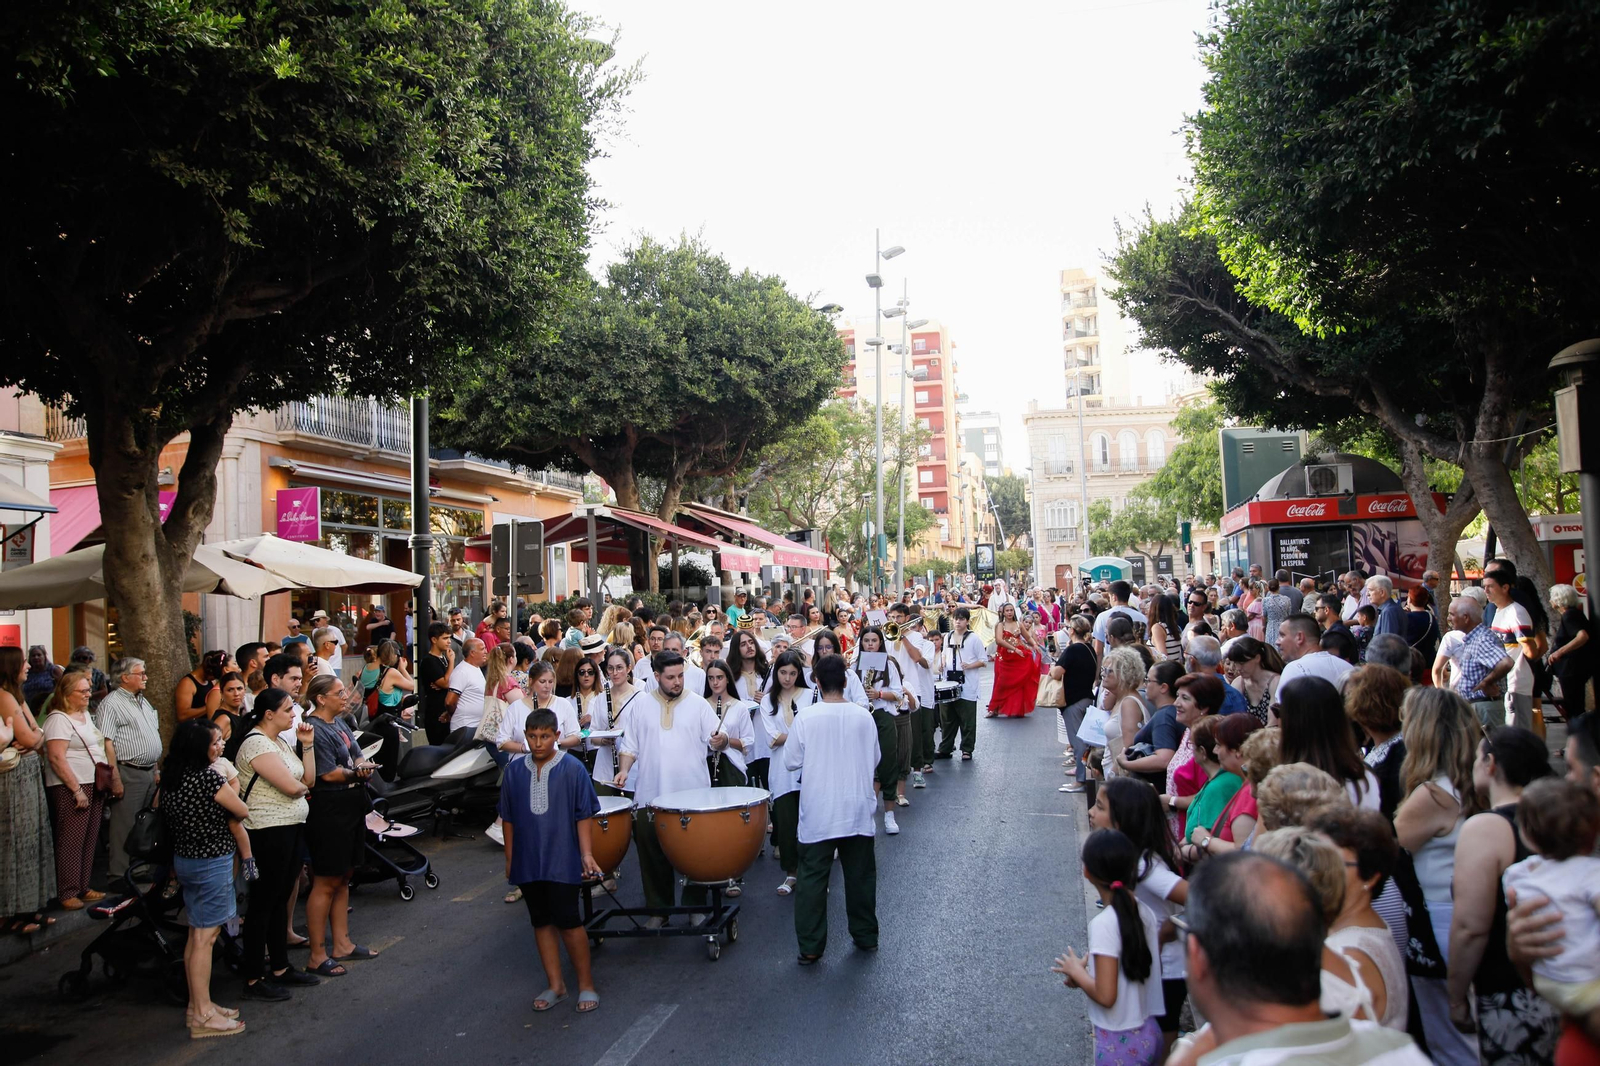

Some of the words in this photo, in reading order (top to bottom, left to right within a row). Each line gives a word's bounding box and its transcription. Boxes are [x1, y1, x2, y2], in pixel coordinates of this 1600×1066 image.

[1286, 503, 1328, 517] Coca-Cola
[1368, 498, 1409, 514] Coca-Cola
[1279, 538, 1310, 546] BALLANTINE'S
